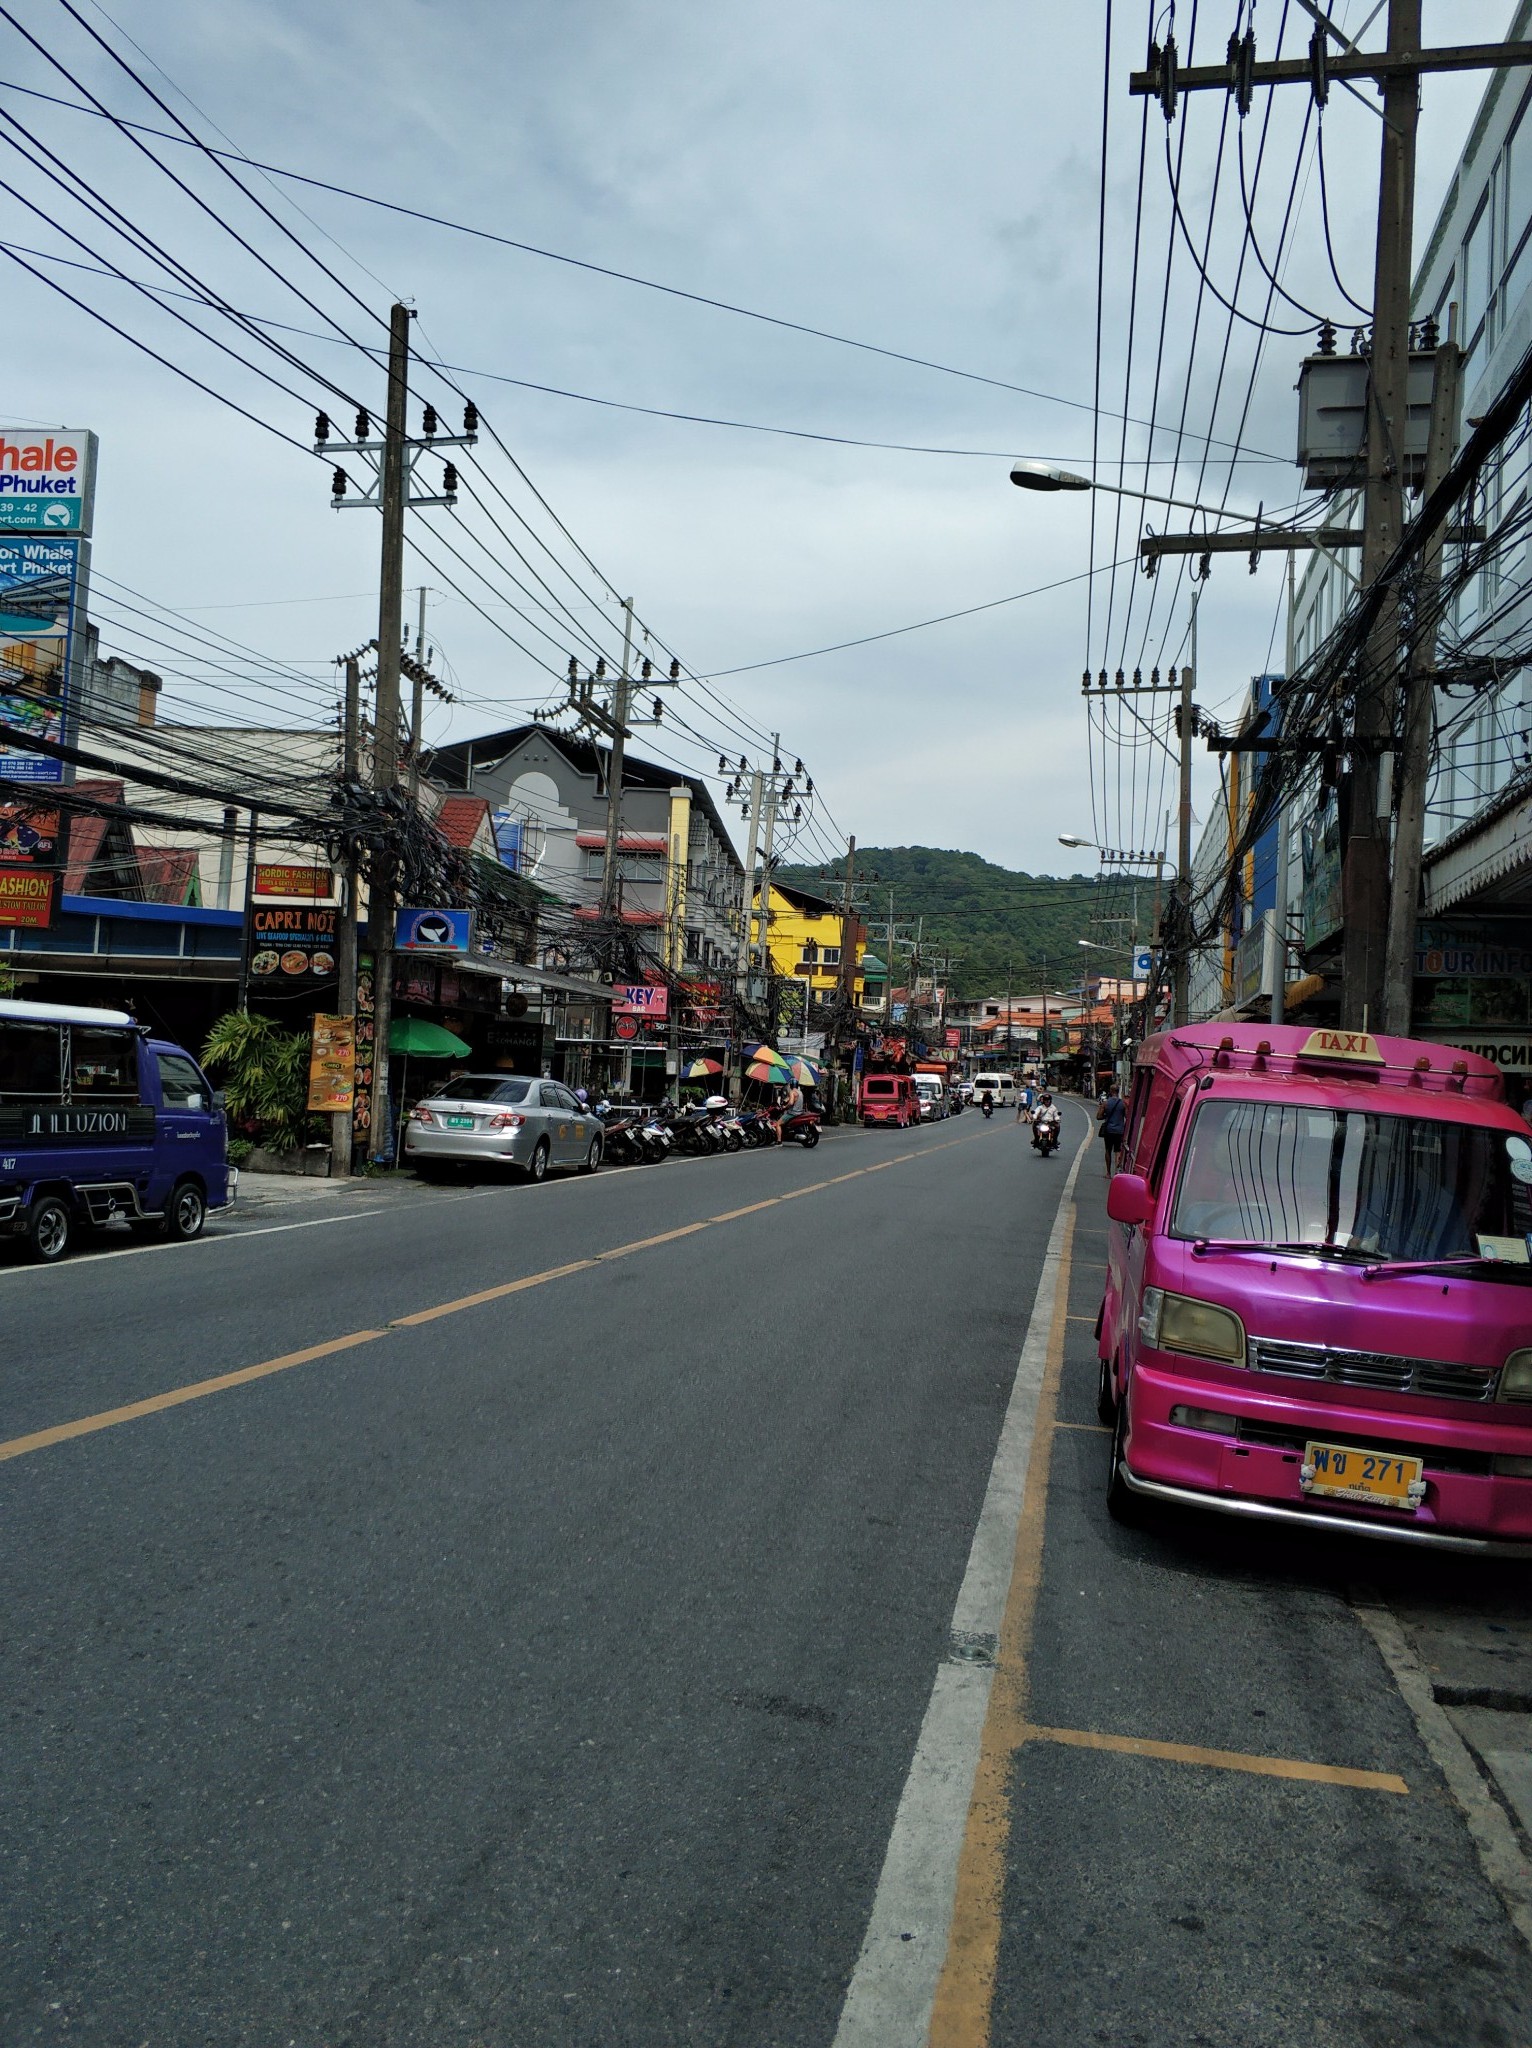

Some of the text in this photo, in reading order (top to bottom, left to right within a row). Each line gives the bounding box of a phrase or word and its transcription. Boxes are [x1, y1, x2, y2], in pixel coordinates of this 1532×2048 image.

[0, 475, 76, 494] Phuket
[23, 503, 38, 513] 42
[23, 545, 74, 560] Whale
[22, 562, 73, 575] Phuket
[259, 867, 327, 880] NORDIC FASHION
[254, 911, 302, 931] CAPRI
[267, 932, 289, 941] SEAFOOD
[626, 988, 655, 1005] KEY
[1317, 1031, 1369, 1053] TAXI
[335, 1094, 348, 1102] 270
[50, 1112, 127, 1134] ILLUZION
[1362, 1457, 1404, 1484] 271
